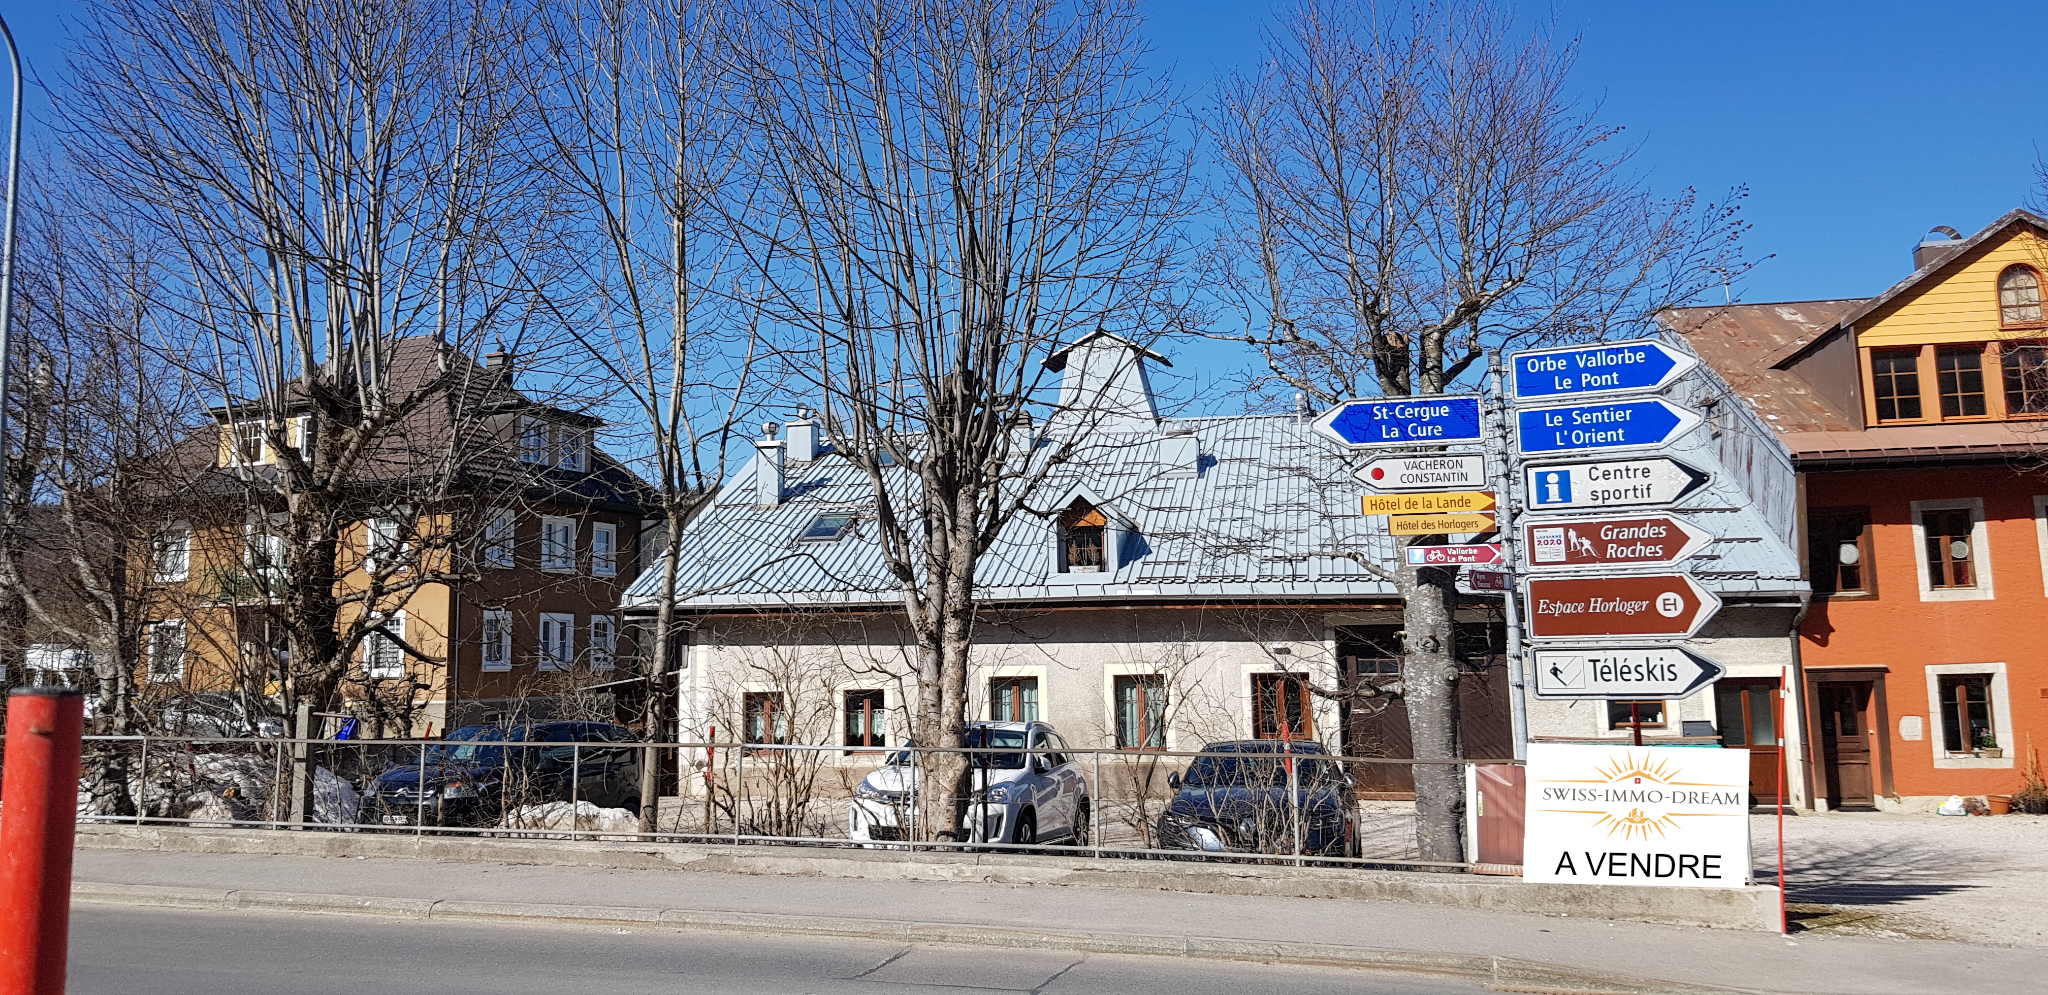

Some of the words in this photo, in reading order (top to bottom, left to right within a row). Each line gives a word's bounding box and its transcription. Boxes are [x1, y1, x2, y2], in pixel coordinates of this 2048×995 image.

[1527, 356, 1567, 373] Orbe
[1576, 349, 1646, 368] Vallorbe
[1554, 376, 1572, 390] Le
[1582, 371, 1619, 387] Pont
[1373, 405, 1450, 422] St-Cergue
[1545, 412, 1563, 427] Le
[1572, 407, 1632, 424] Sentier
[1382, 425, 1399, 438] La
[1408, 423, 1443, 437] Cure
[1556, 427, 1625, 446] L'Orient
[1404, 459, 1463, 471] VACHERON
[1588, 465, 1651, 481] Centre
[1400, 472, 1468, 484] CONSTANTIN
[1370, 498, 1400, 511] Hôtel
[1404, 497, 1418, 509] de
[1422, 497, 1433, 509] la
[1437, 495, 1471, 508] Lande
[1590, 484, 1652, 504] sportif
[1397, 519, 1419, 530] Hôtel
[1421, 519, 1436, 530] des
[1438, 518, 1479, 531] Horlogers
[1600, 523, 1667, 540] Grandes
[1606, 542, 1663, 558] Roches
[1537, 599, 1584, 617] Espace
[1588, 597, 1649, 615] Horloger
[1588, 657, 1678, 682] Téléskis
[1542, 787, 1741, 806] SWISS-IMMO-DREAM
[1554, 851, 1577, 876] A
[1585, 851, 1722, 879] VENDRE
